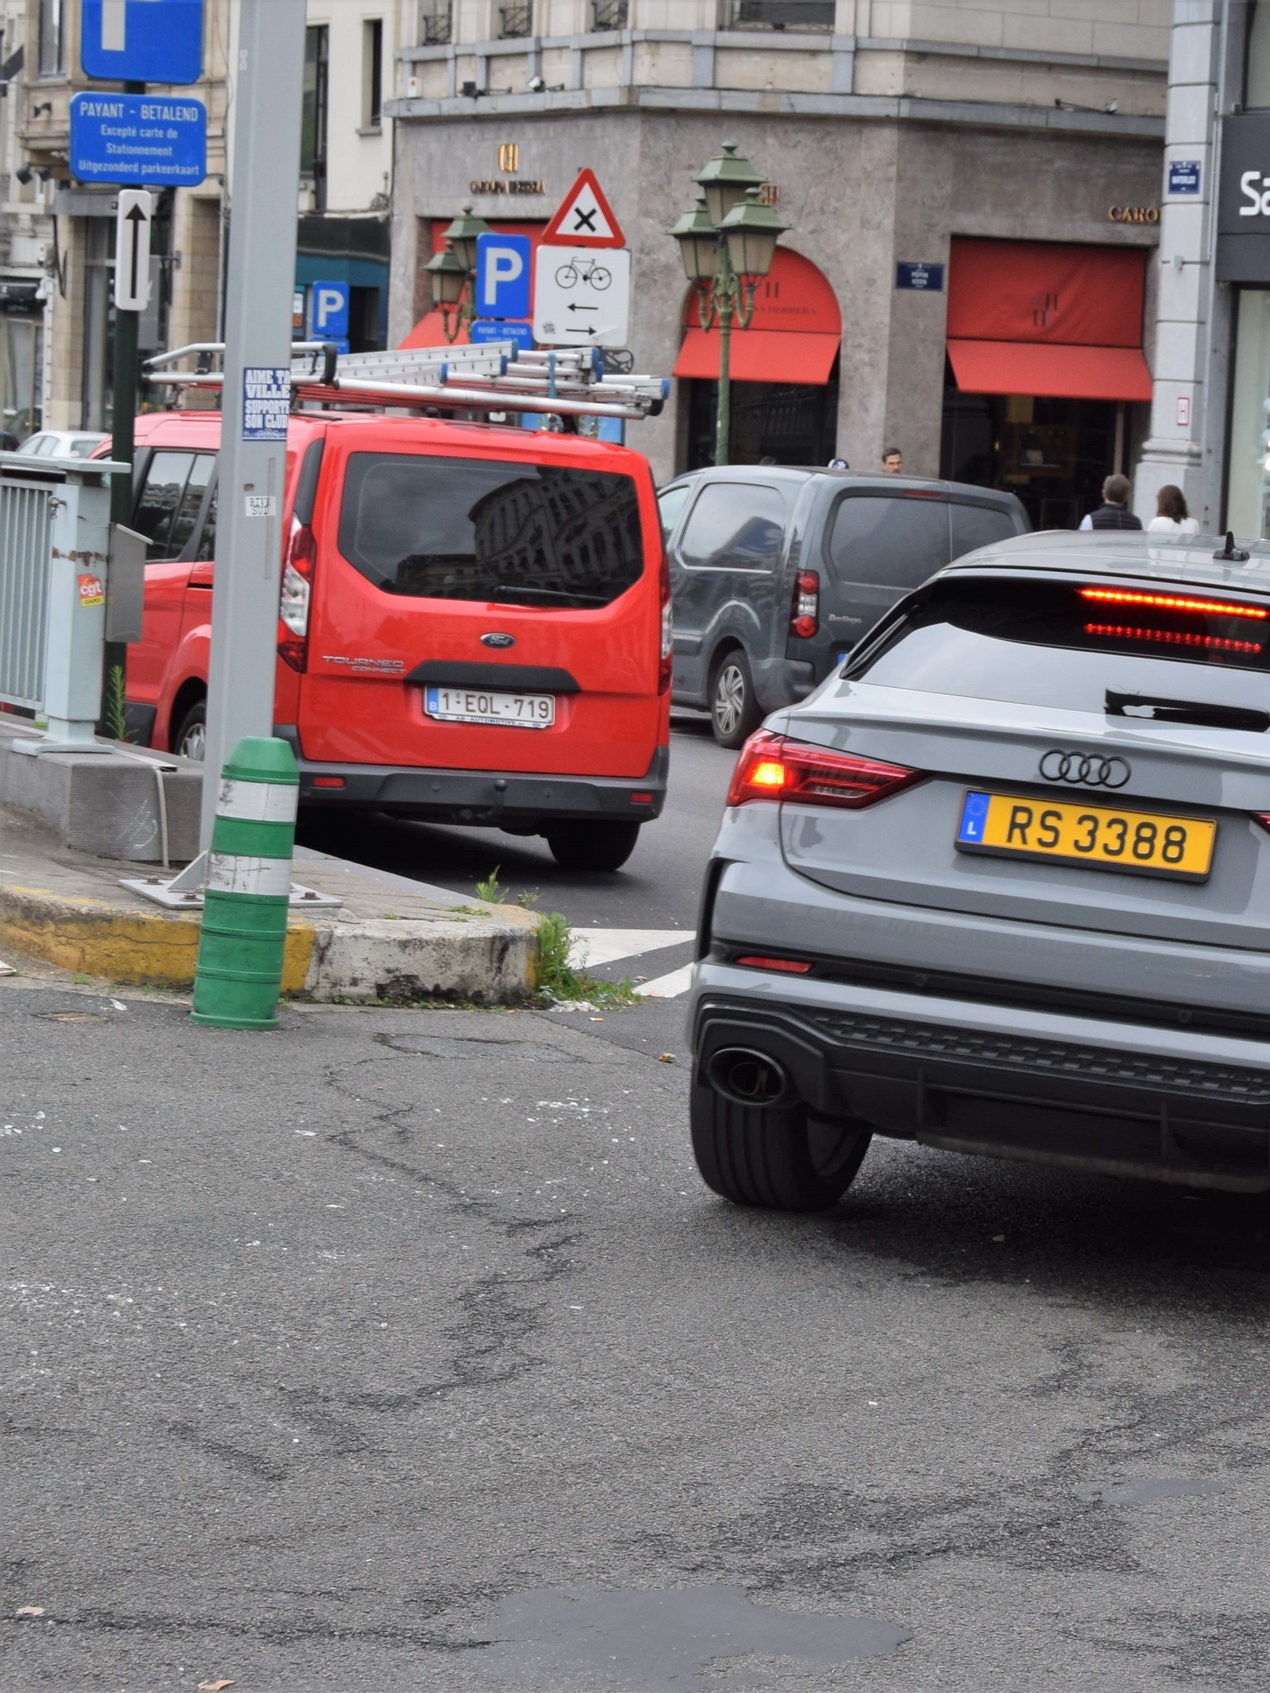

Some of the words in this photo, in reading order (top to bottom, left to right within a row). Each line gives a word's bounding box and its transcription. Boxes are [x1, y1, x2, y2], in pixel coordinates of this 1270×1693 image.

[79, 102, 125, 118] PAYANT
[140, 104, 199, 122] BETALEND
[100, 124, 138, 139] Excepté
[139, 127, 165, 139] carte
[166, 127, 179, 139] de
[105, 142, 173, 157] Stationnement
[78, 159, 139, 174] Uitgezonderd
[141, 163, 200, 176] parkeerkaart
[484, 246, 524, 306] P
[318, 289, 345, 328] P
[245, 369, 274, 384] AIME
[245, 384, 291, 399] VILLE
[244, 414, 264, 429] SON
[80, 580, 102, 597] cgt
[828, 613, 862, 625] Berlingo
[322, 655, 404, 667] TOURNEO
[351, 665, 406, 674] CONNECT
[430, 701, 438, 711] B
[966, 821, 977, 836] L
[1006, 805, 1063, 848] RS
[1073, 814, 1187, 864] 3388
